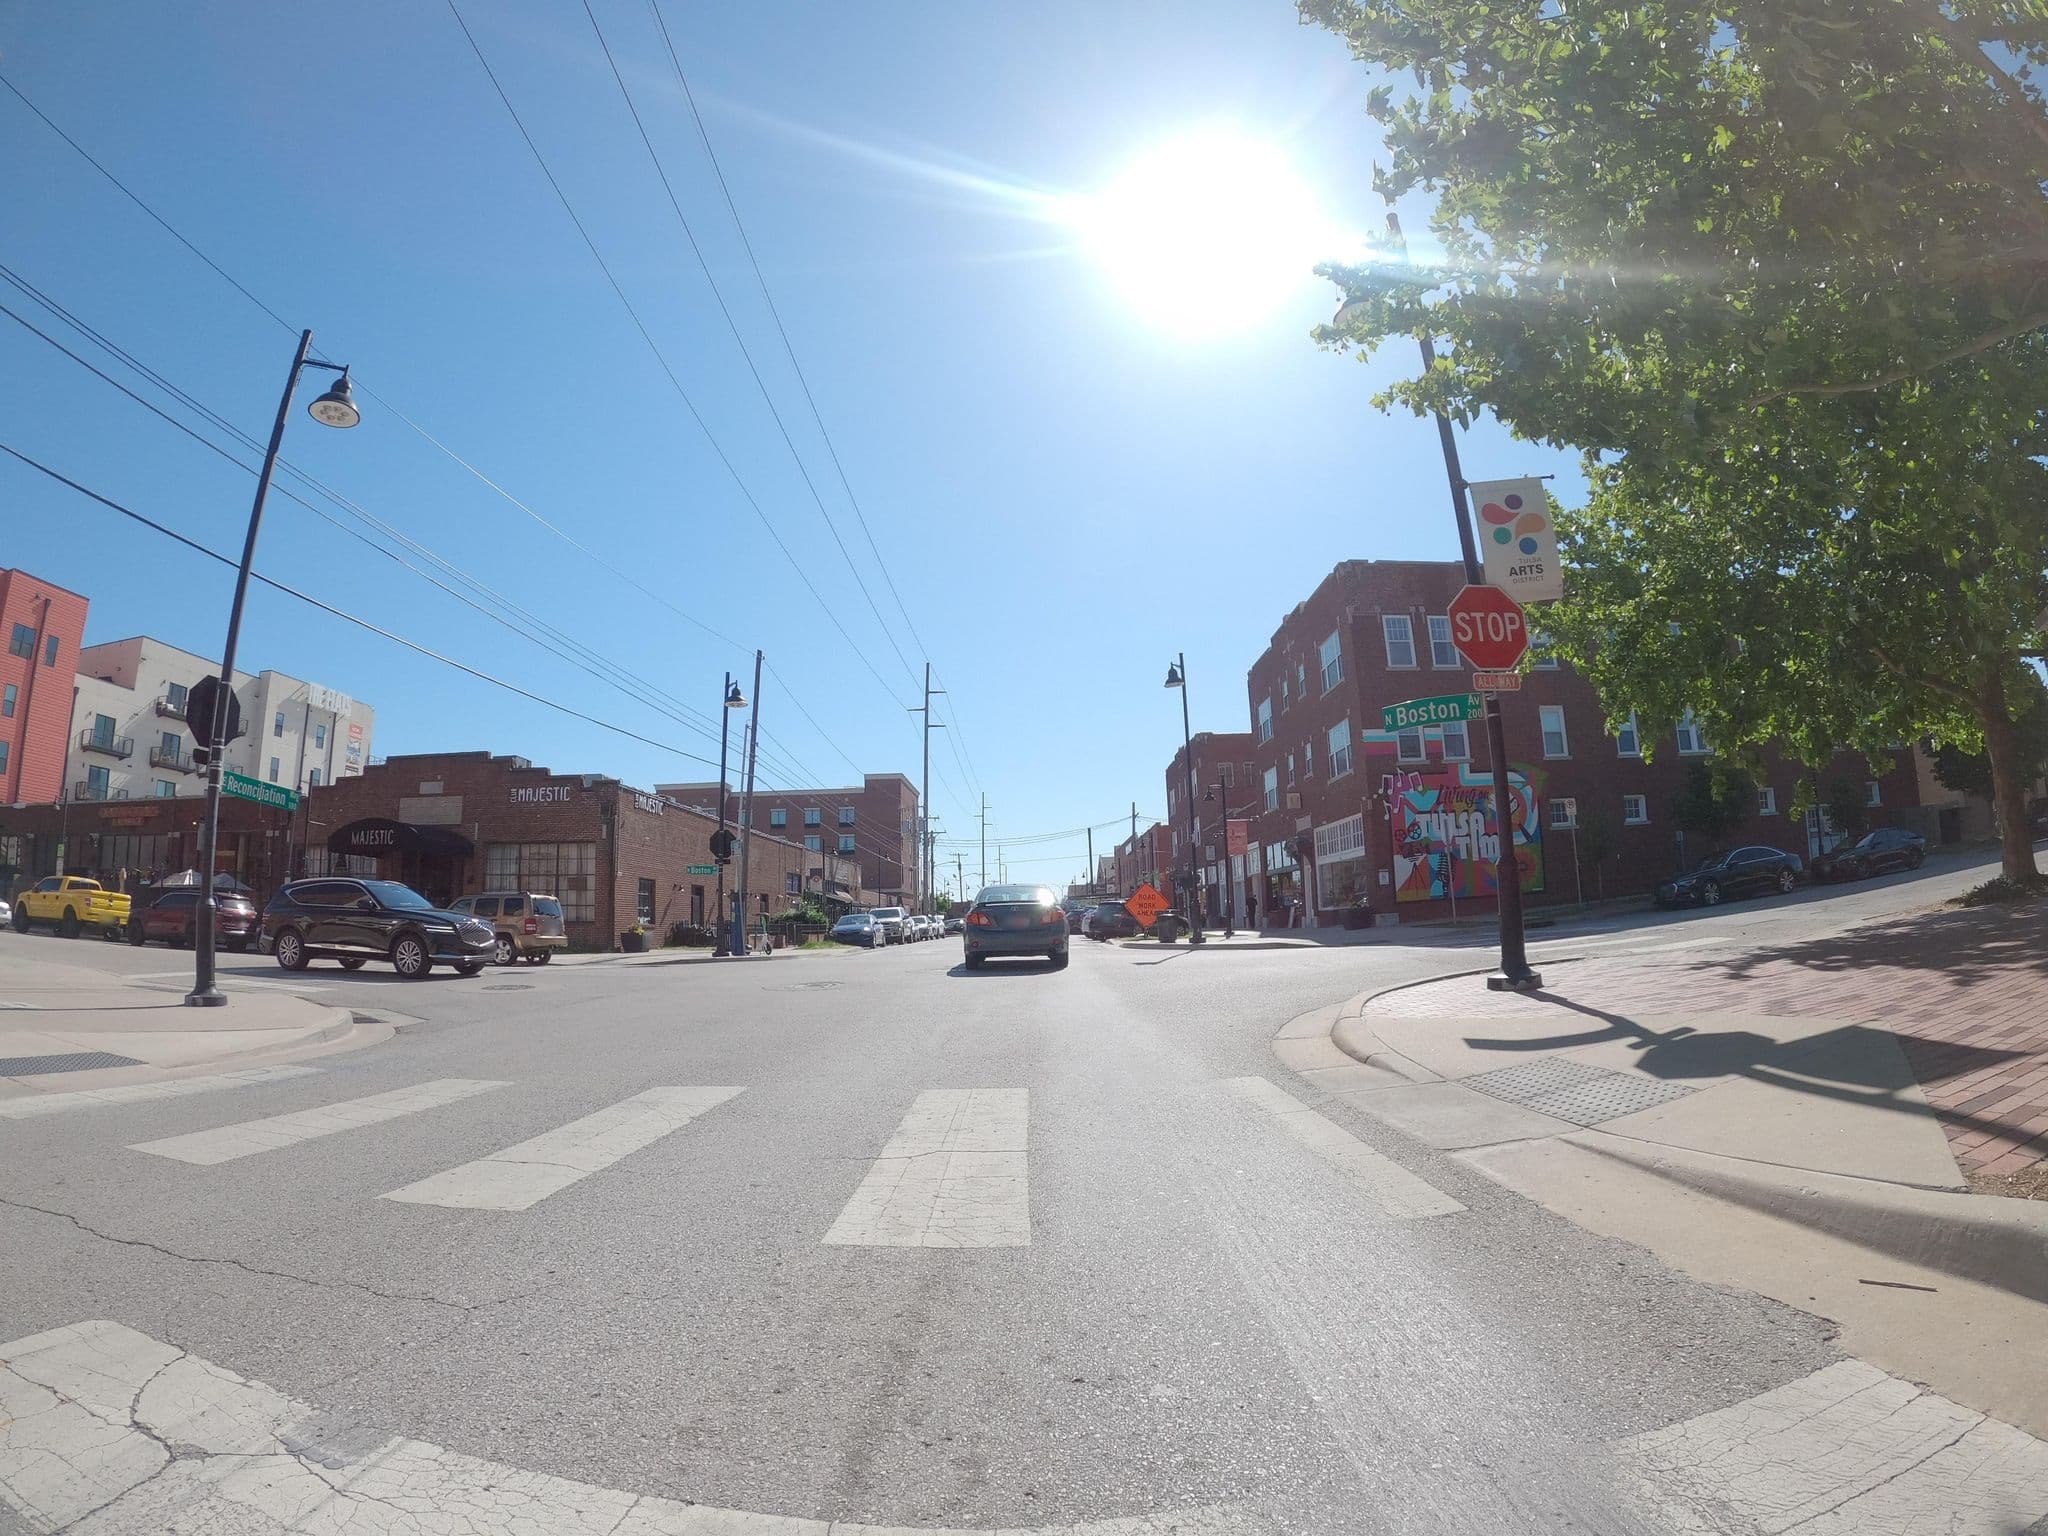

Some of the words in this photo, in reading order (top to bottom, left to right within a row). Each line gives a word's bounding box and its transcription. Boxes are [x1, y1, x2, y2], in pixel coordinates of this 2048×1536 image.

[1509, 564, 1544, 577] ARTS
[1512, 576, 1544, 584] DISTRICT
[1455, 612, 1521, 642] STOP
[1478, 677, 1495, 687] ALL
[1496, 677, 1517, 687] WAY
[1385, 714, 1392, 725] N
[1396, 701, 1460, 726] Boston
[1467, 694, 1480, 706] Av
[1467, 708, 1483, 719] 200
[227, 775, 286, 806] Reconciliation
[518, 786, 571, 802] MAJESTIC
[639, 794, 664, 816] MAJESTIC
[1416, 809, 1488, 845] TULSA
[351, 829, 394, 846] MAJESTIC
[1456, 832, 1501, 861] TIM
